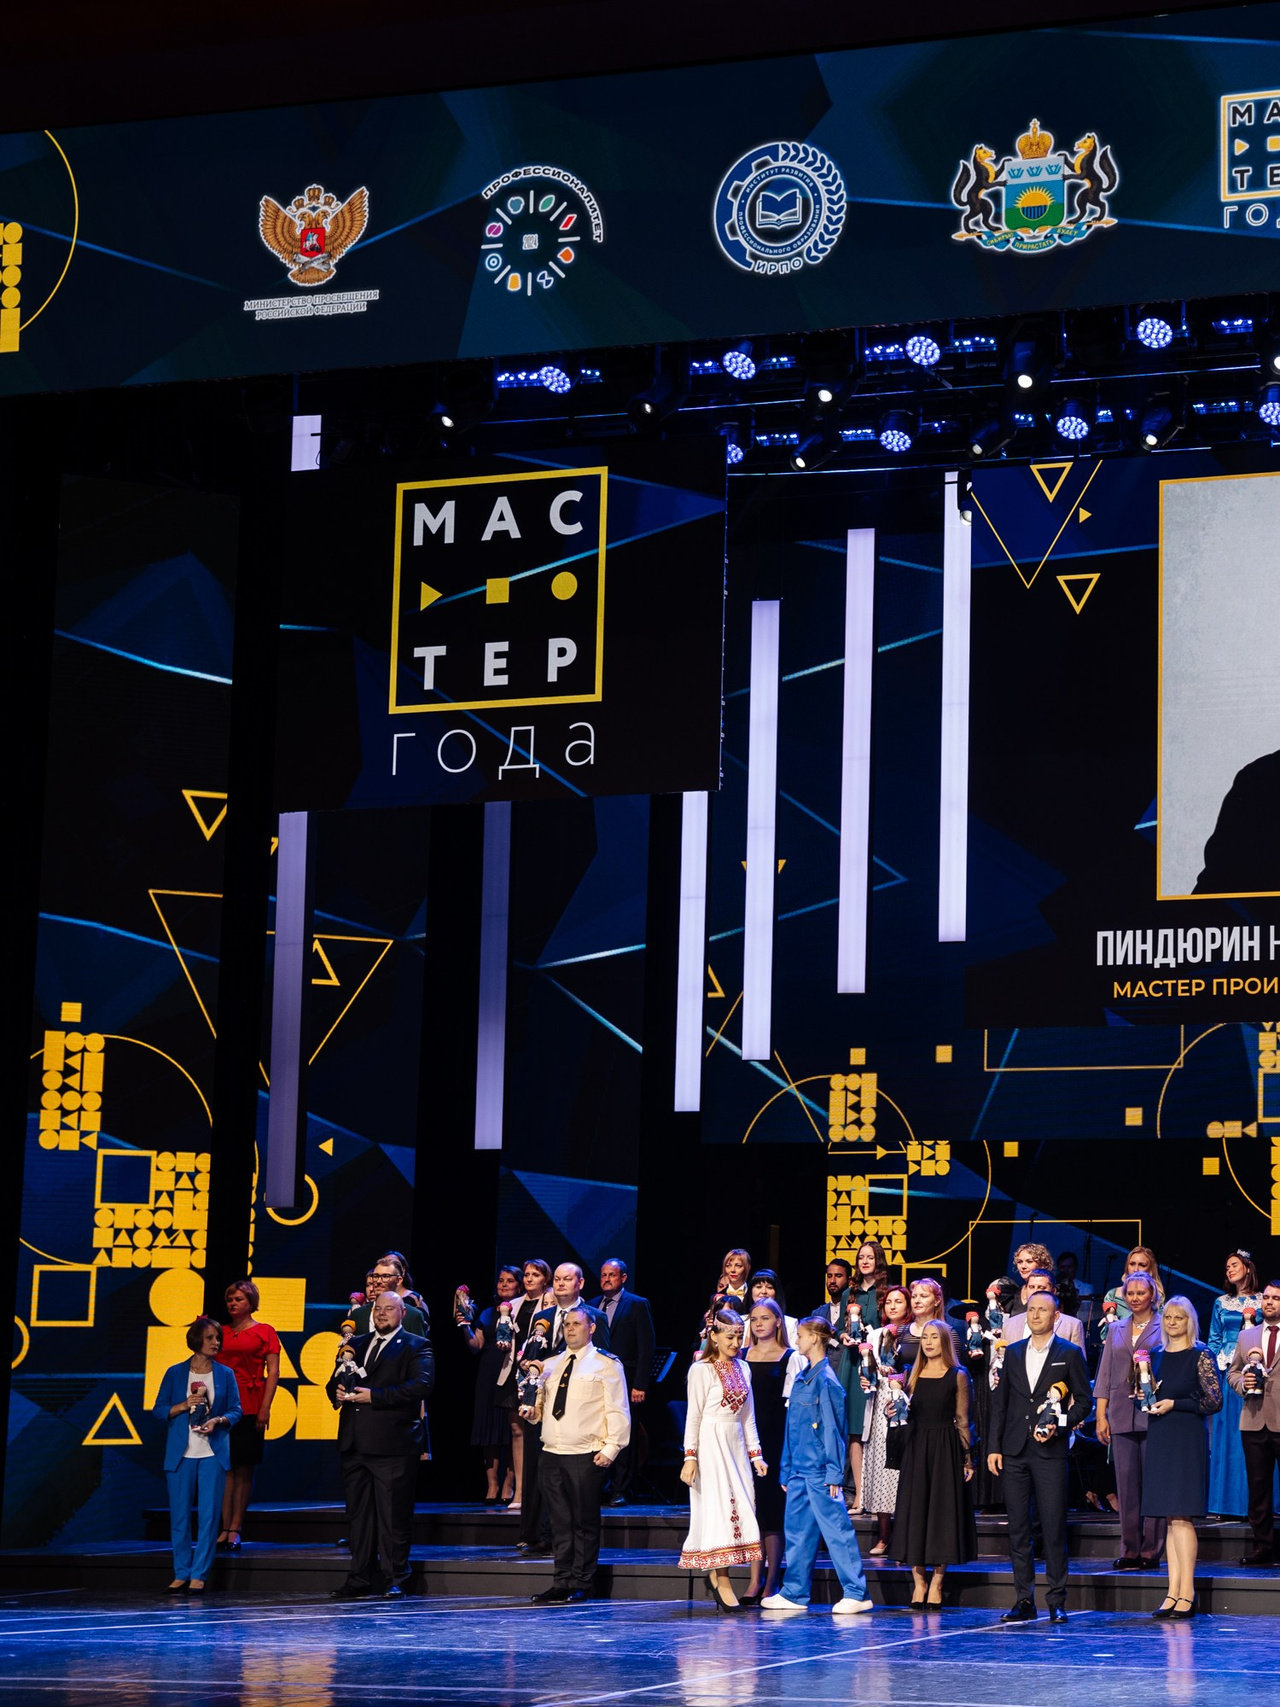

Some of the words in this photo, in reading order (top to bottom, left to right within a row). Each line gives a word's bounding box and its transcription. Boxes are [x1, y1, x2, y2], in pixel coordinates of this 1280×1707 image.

[745, 168, 779, 193] ИНСТИТУТ
[781, 168, 814, 188] РАЗВИТИЯ
[482, 166, 603, 242] ПРОФЕССИОНАЛИТЕТ
[523, 234, 538, 250] 2024
[738, 211, 791, 254] ПРОФЕССИОНАЛЬНОГО
[793, 204, 820, 249] ОБРАЗОВАНИЯ
[754, 257, 803, 275] ИРПО
[244, 295, 313, 310] МИНИСТЕРСТВО
[313, 289, 379, 304] ПРОСВЕЩЕНИЯ
[255, 306, 313, 320] РОССИЙСКОЙ
[314, 302, 367, 316] ФЕДЕРАЦИИ
[413, 490, 584, 547] МАС
[413, 637, 578, 691] ТЕР
[391, 721, 595, 781] года
[1096, 926, 1261, 969] ПИНДЮРИН
[1113, 979, 1206, 999] МАСТЕР
